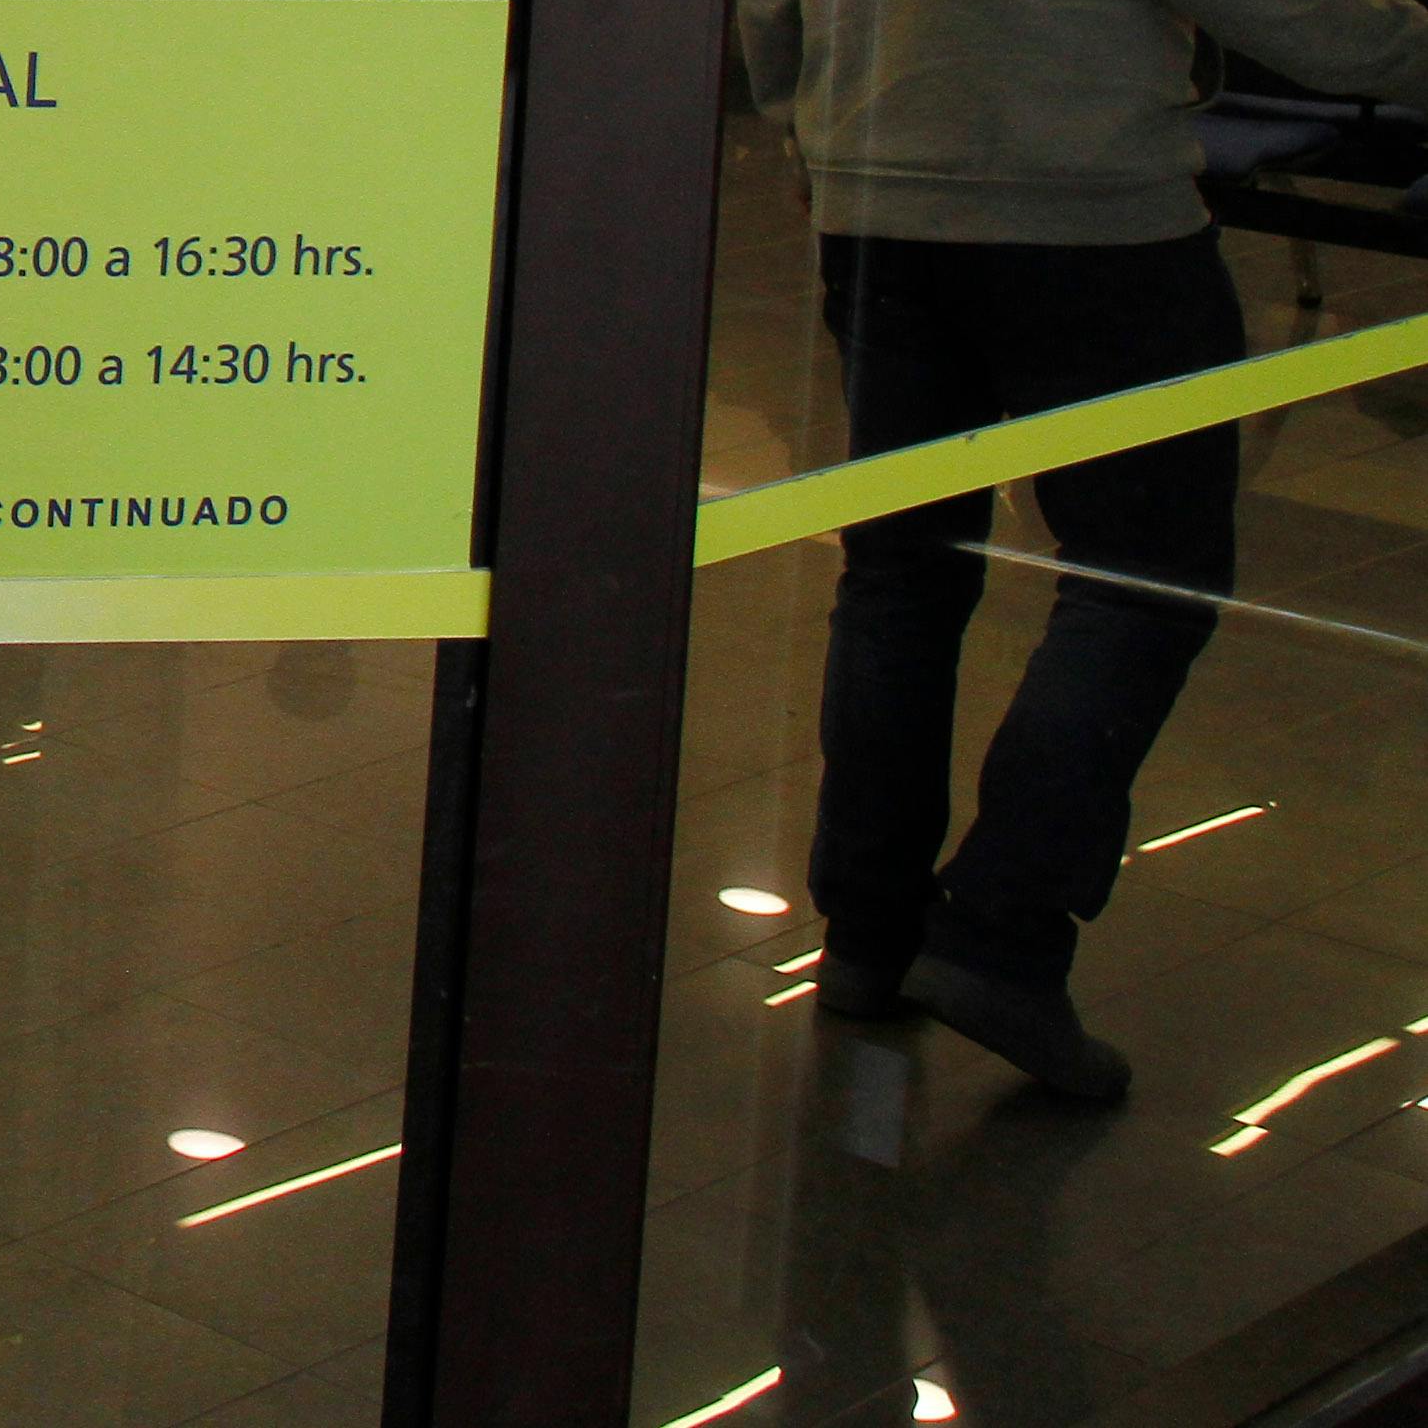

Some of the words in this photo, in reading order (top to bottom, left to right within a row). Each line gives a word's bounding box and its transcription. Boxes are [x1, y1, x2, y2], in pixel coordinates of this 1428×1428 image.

[104, 246, 131, 278] a
[154, 235, 277, 277] 16:30
[292, 233, 374, 277] hrs.
[97, 354, 124, 386] a
[145, 343, 271, 385] 14:30
[285, 341, 367, 384] hrs.
